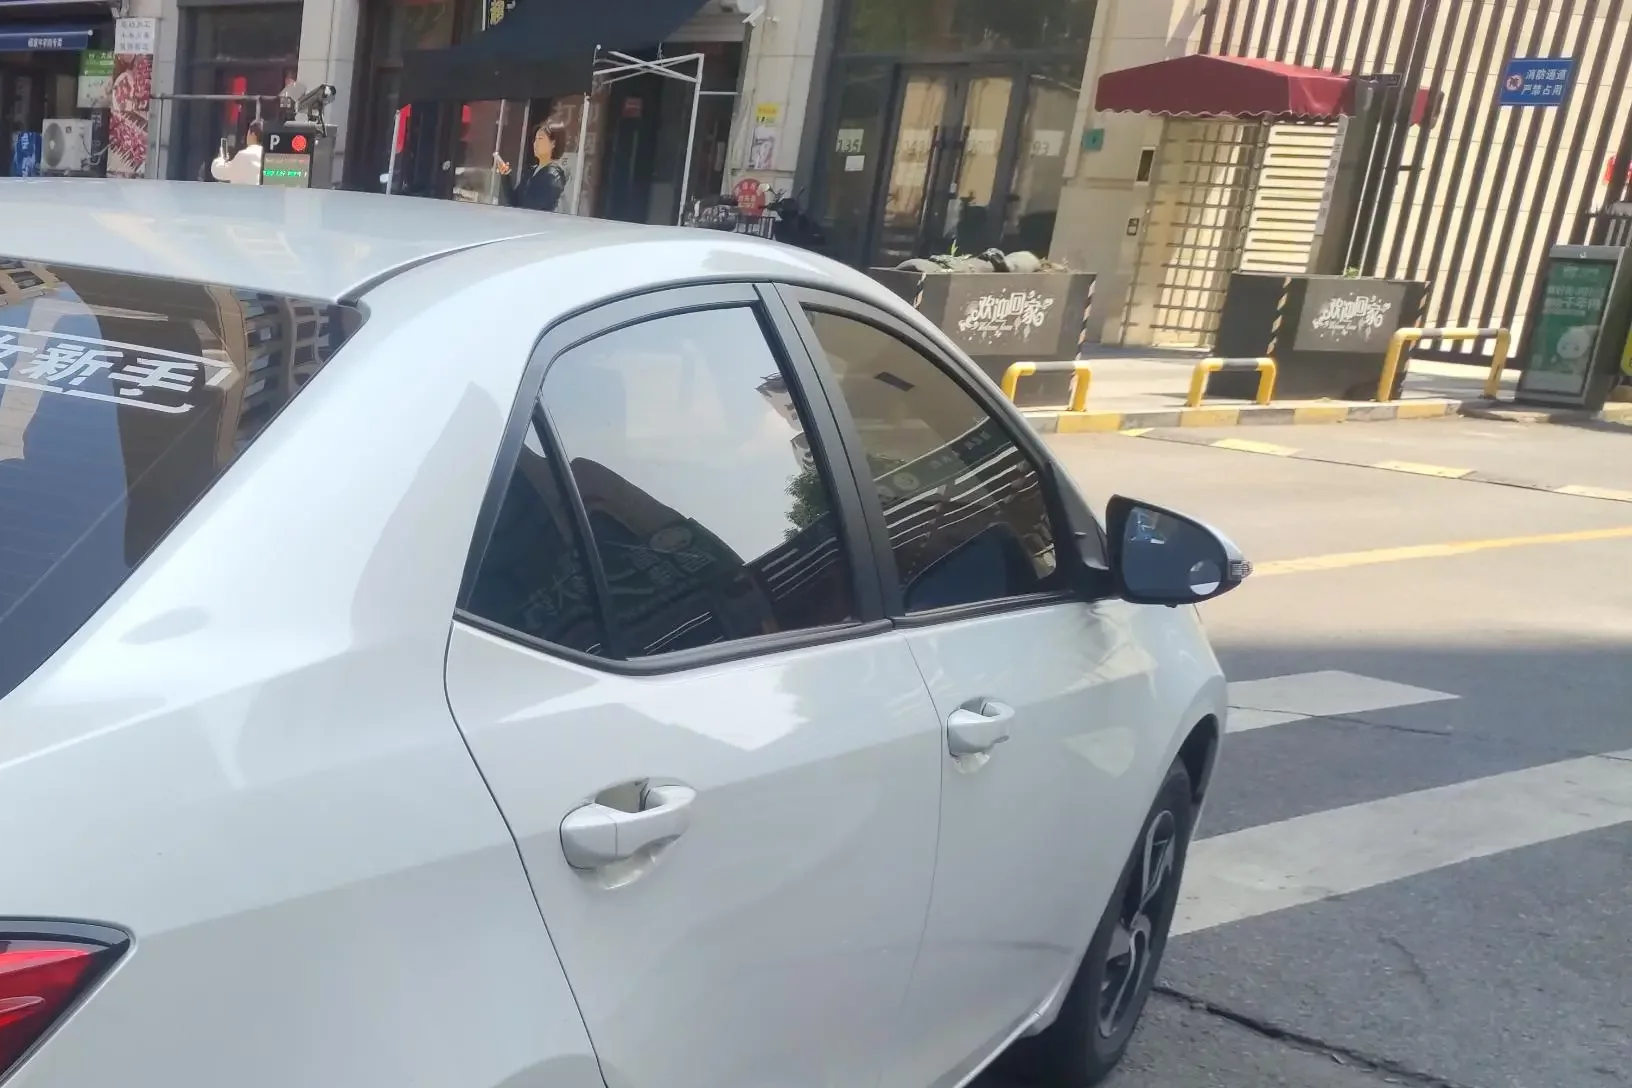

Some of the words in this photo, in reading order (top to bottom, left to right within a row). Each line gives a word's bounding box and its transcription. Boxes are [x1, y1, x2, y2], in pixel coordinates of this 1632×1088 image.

[1525, 68, 1567, 80] 消防通道
[1521, 84, 1563, 95] 严禁占用
[270, 134, 280, 151] P
